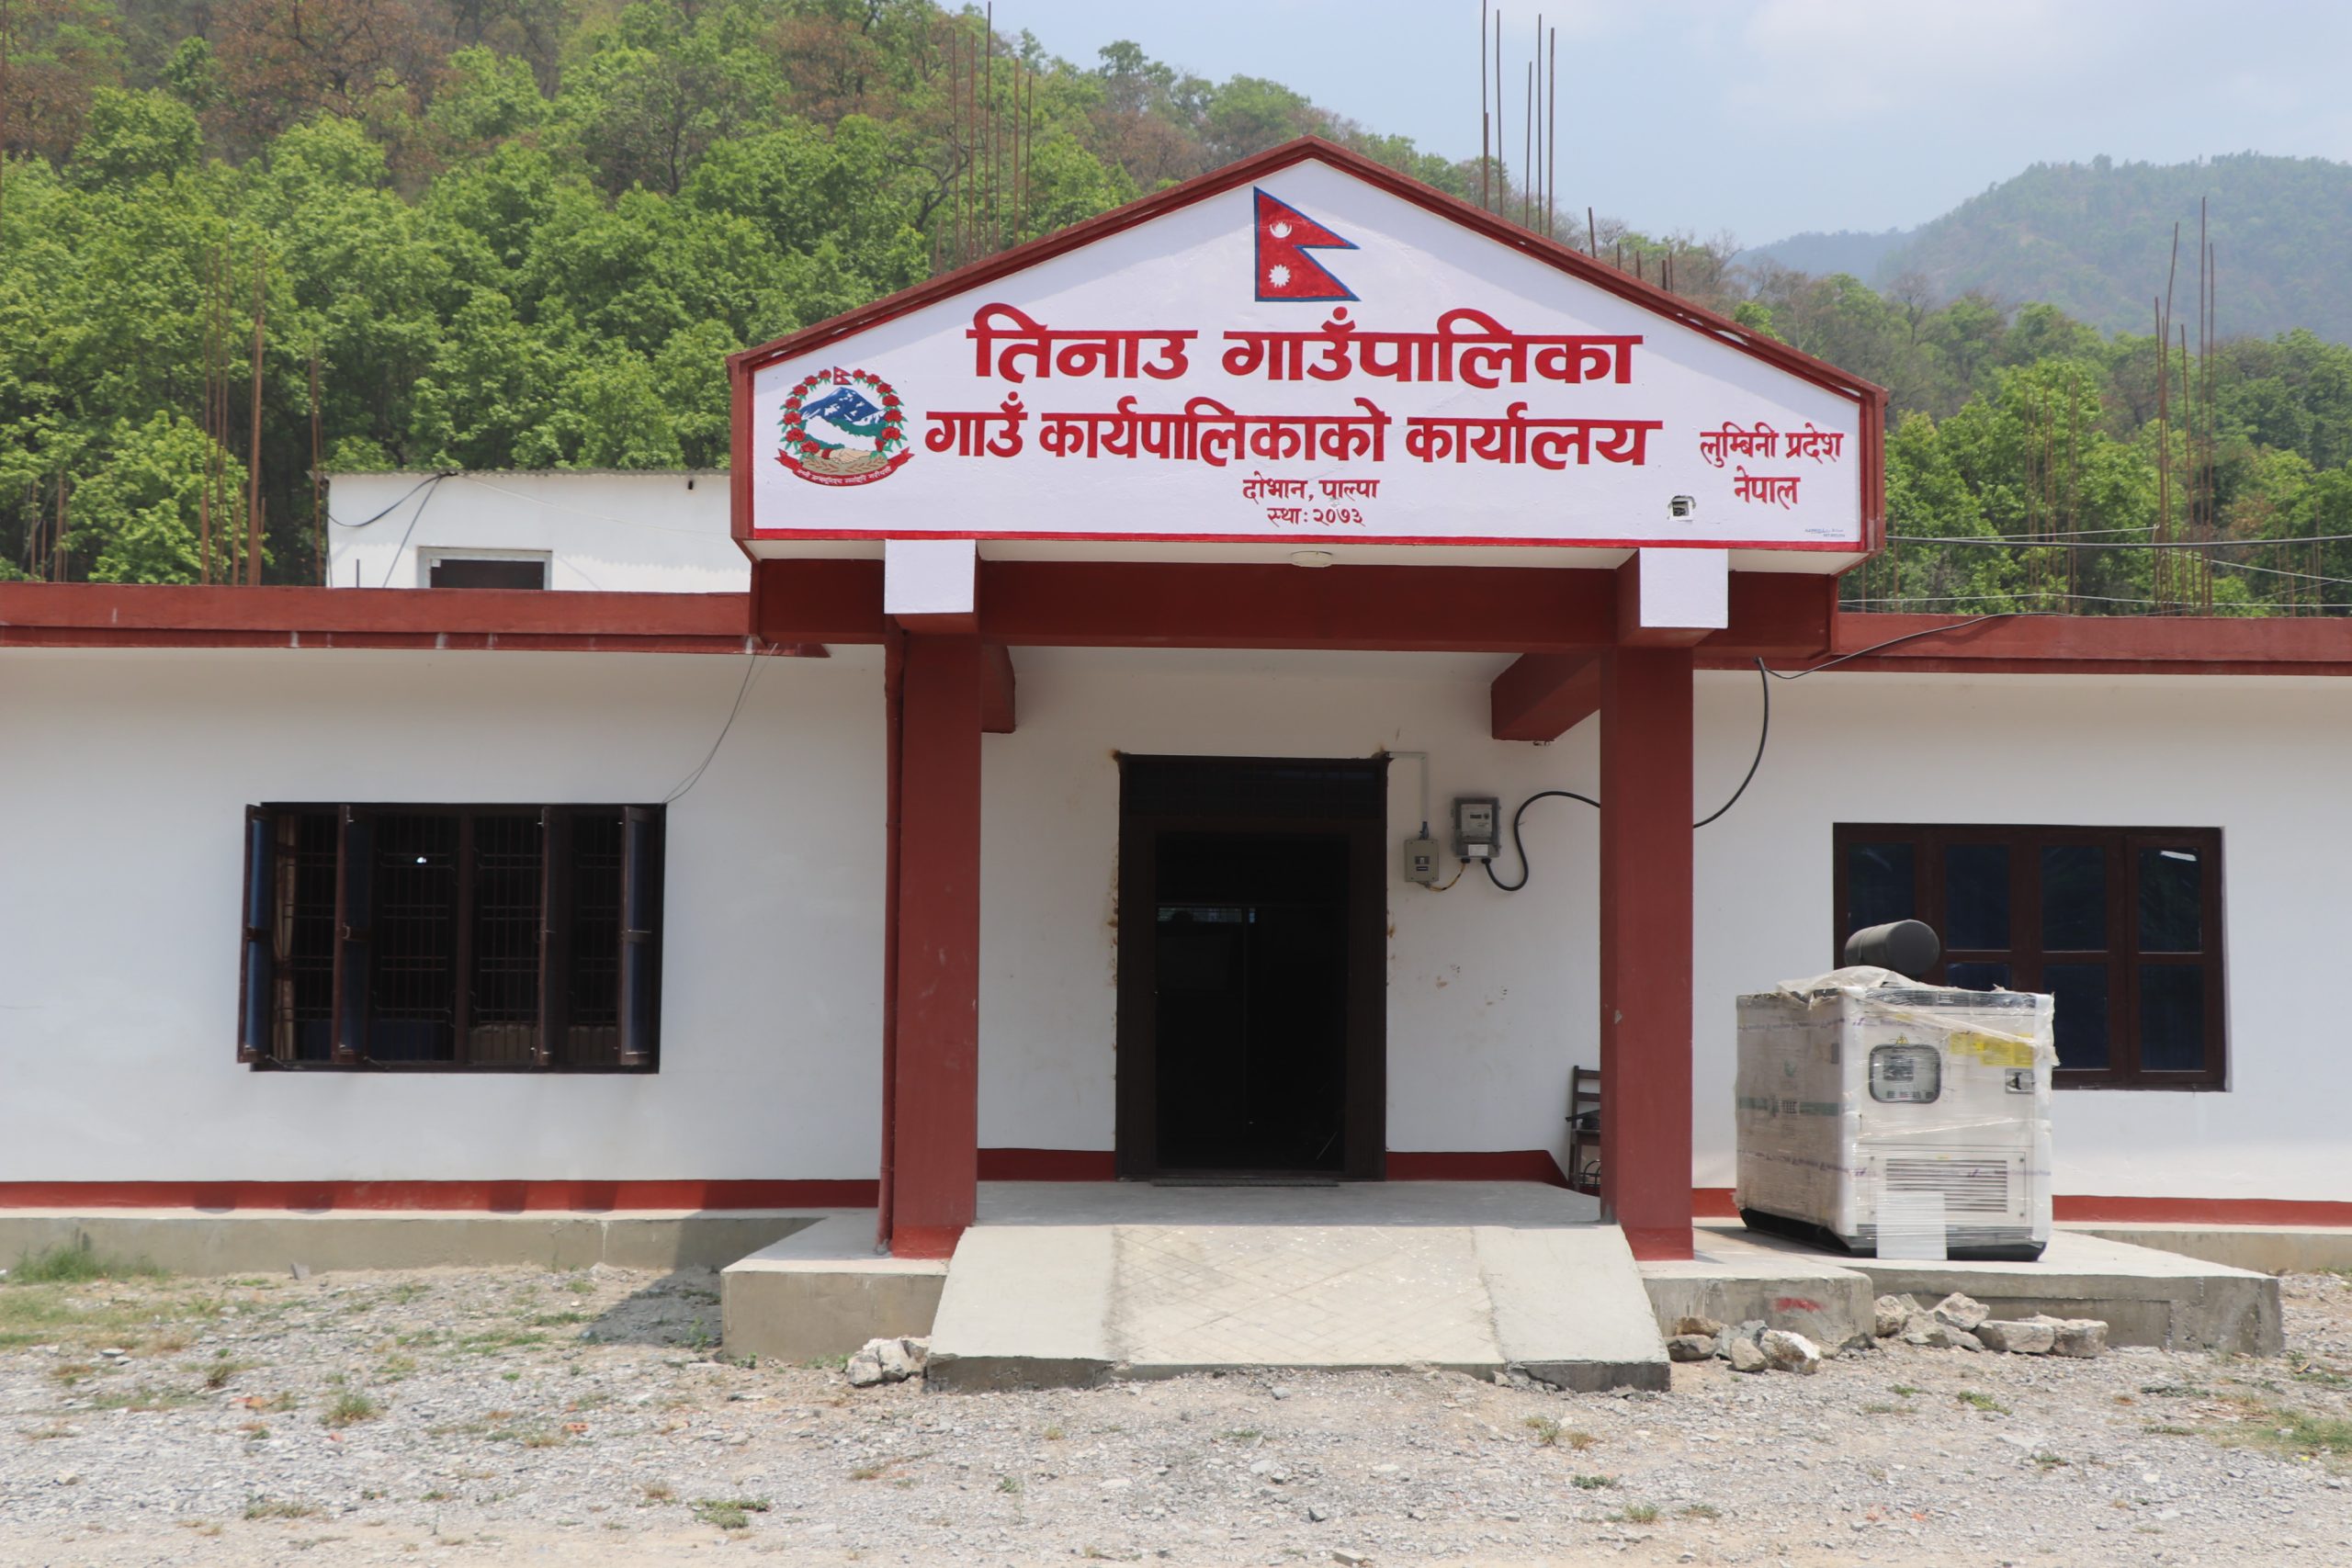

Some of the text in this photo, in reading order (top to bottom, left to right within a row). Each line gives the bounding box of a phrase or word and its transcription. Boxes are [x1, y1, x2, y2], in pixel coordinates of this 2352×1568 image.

[965, 303, 1643, 389] तिनाउ गाउँपालिका
[924, 391, 1664, 470] गाउँ कार्यपालिकाको कार्यालय
[1700, 421, 1845, 468] लुम्बिनी प्रदेश
[1242, 470, 1381, 504] दोभान, पाल्पा
[1734, 465, 1802, 511] नेपाल
[1312, 508, 1366, 526] २०७३
